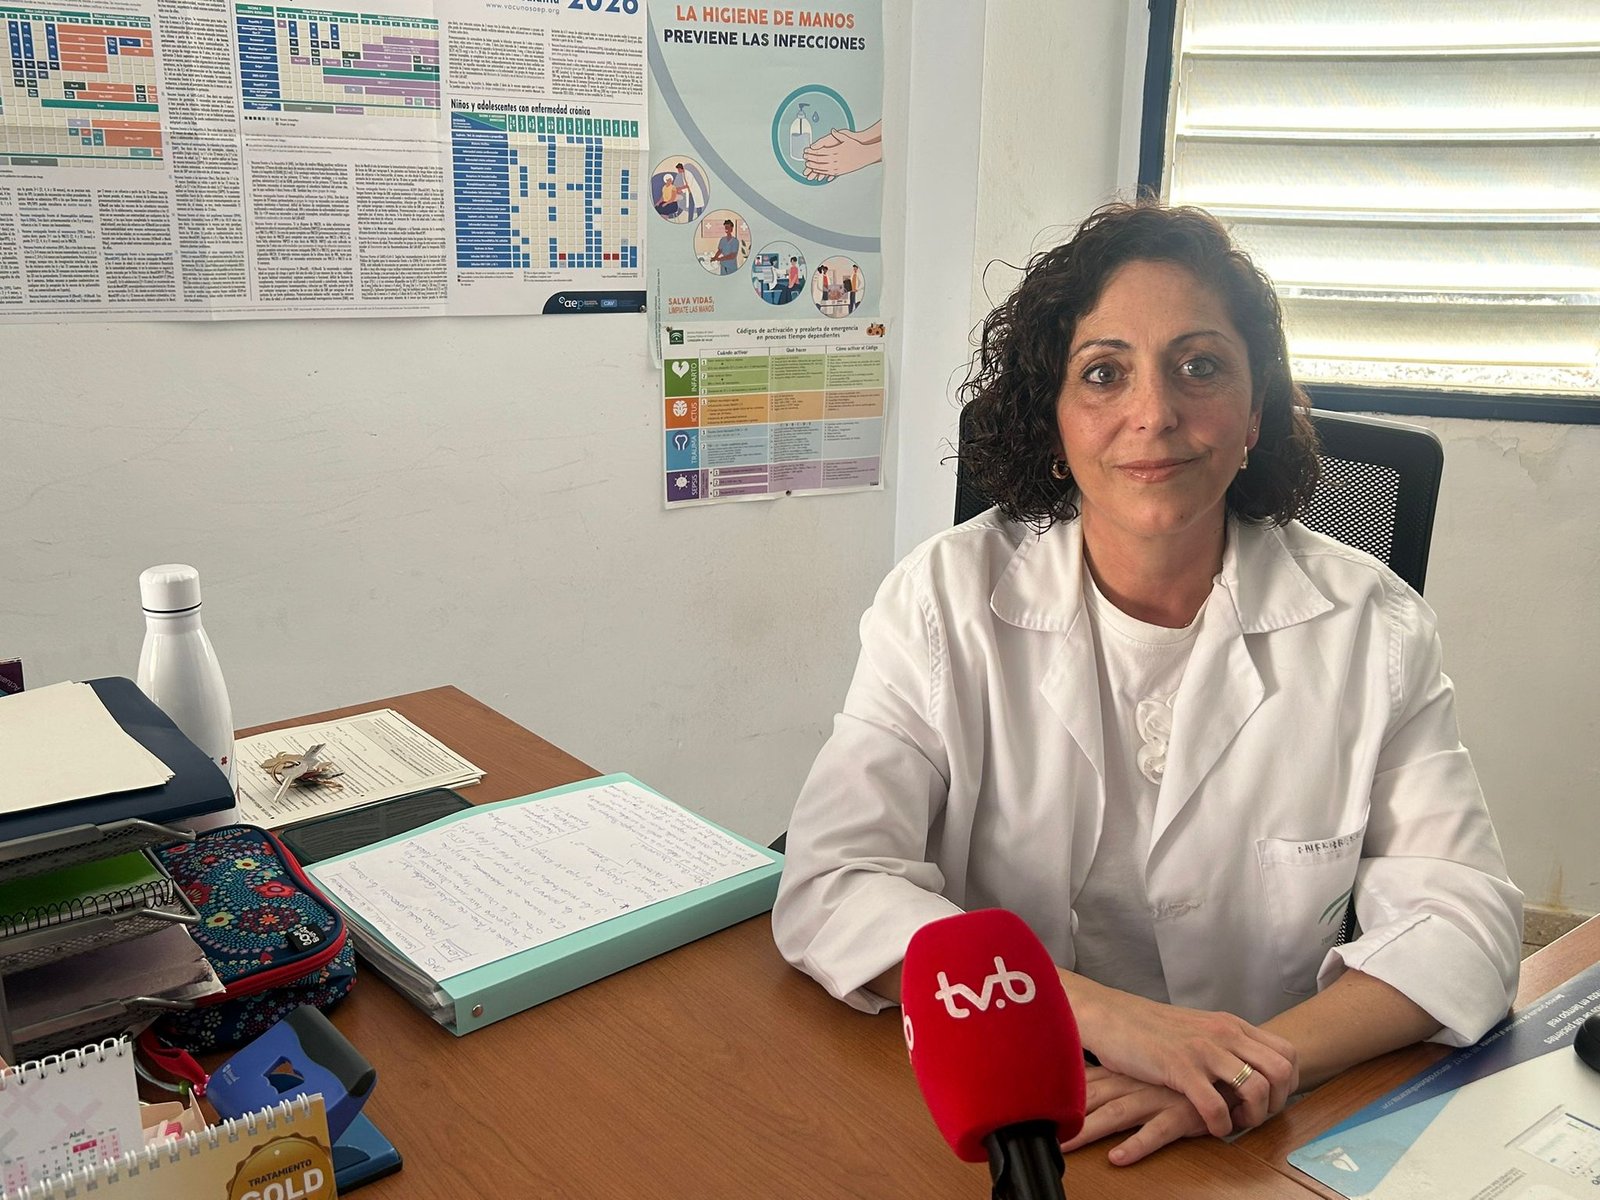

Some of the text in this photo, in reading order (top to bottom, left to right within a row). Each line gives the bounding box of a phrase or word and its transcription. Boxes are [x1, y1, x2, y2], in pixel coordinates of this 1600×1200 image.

[676, 5, 855, 29] LA HIGIENE DE MANOS
[663, 29, 866, 50] PREVIENE LAS INFECCIONES
[450, 99, 591, 115] Niños y adolescentes con enfermedad crónica
[668, 296, 714, 305] SALVA VIDAS,
[736, 327, 757, 335] Códigos
[831, 325, 859, 333] emergencia
[808, 332, 840, 340] dependientes
[690, 435, 698, 464] TRAUMA
[935, 956, 1036, 1019] tv.b
[69, 1129, 85, 1139] Abril
[248, 1159, 312, 1187] TRATAMIENTO
